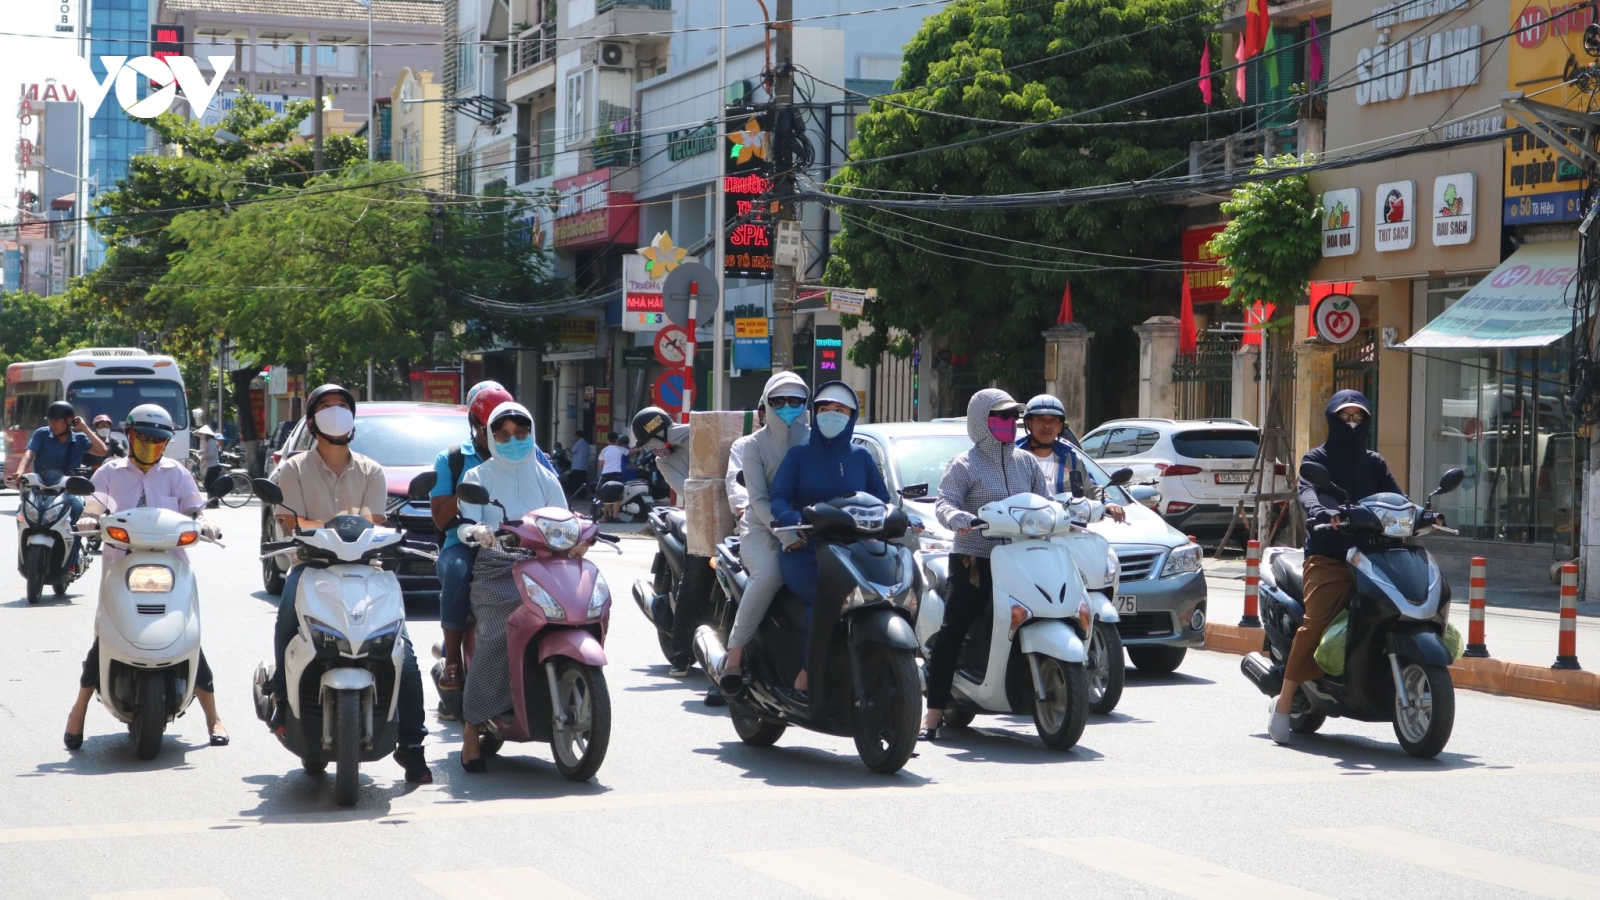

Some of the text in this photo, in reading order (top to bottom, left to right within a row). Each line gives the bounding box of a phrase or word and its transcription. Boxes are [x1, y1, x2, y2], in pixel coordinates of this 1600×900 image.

[1409, 25, 1479, 95] XANH
[1520, 196, 1531, 216] 50
[730, 224, 768, 246] SPA
[1326, 229, 1352, 249] HOA QUẢ
[1378, 225, 1409, 245] THỊT SẠCH
[1436, 220, 1468, 238] RAU SẠCH
[627, 295, 663, 308] NHÀ HÀ
[821, 361, 836, 370] SPA
[1118, 596, 1134, 612] 75
